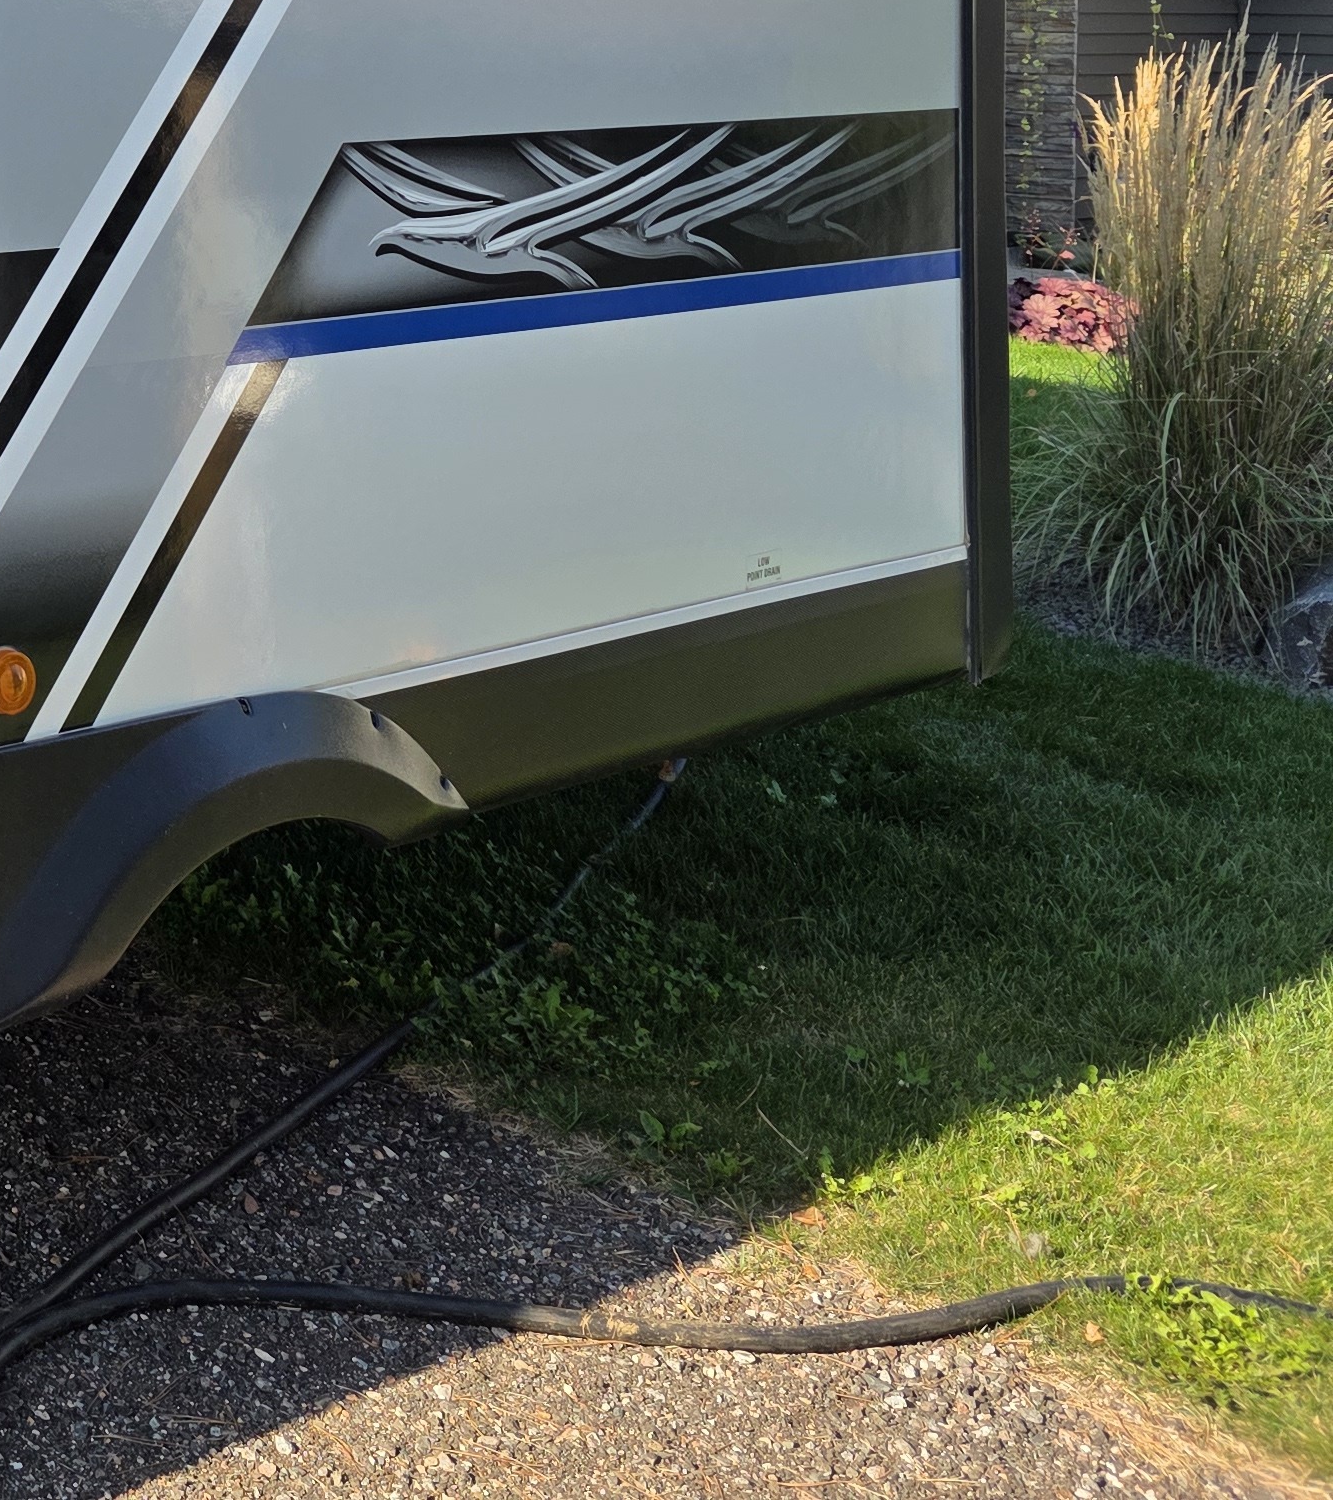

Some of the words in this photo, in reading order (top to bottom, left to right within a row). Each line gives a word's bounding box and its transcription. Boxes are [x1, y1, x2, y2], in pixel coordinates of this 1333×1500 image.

[757, 556, 771, 567] LOW
[746, 569, 764, 582] POINT
[764, 565, 781, 578] DRAIN
